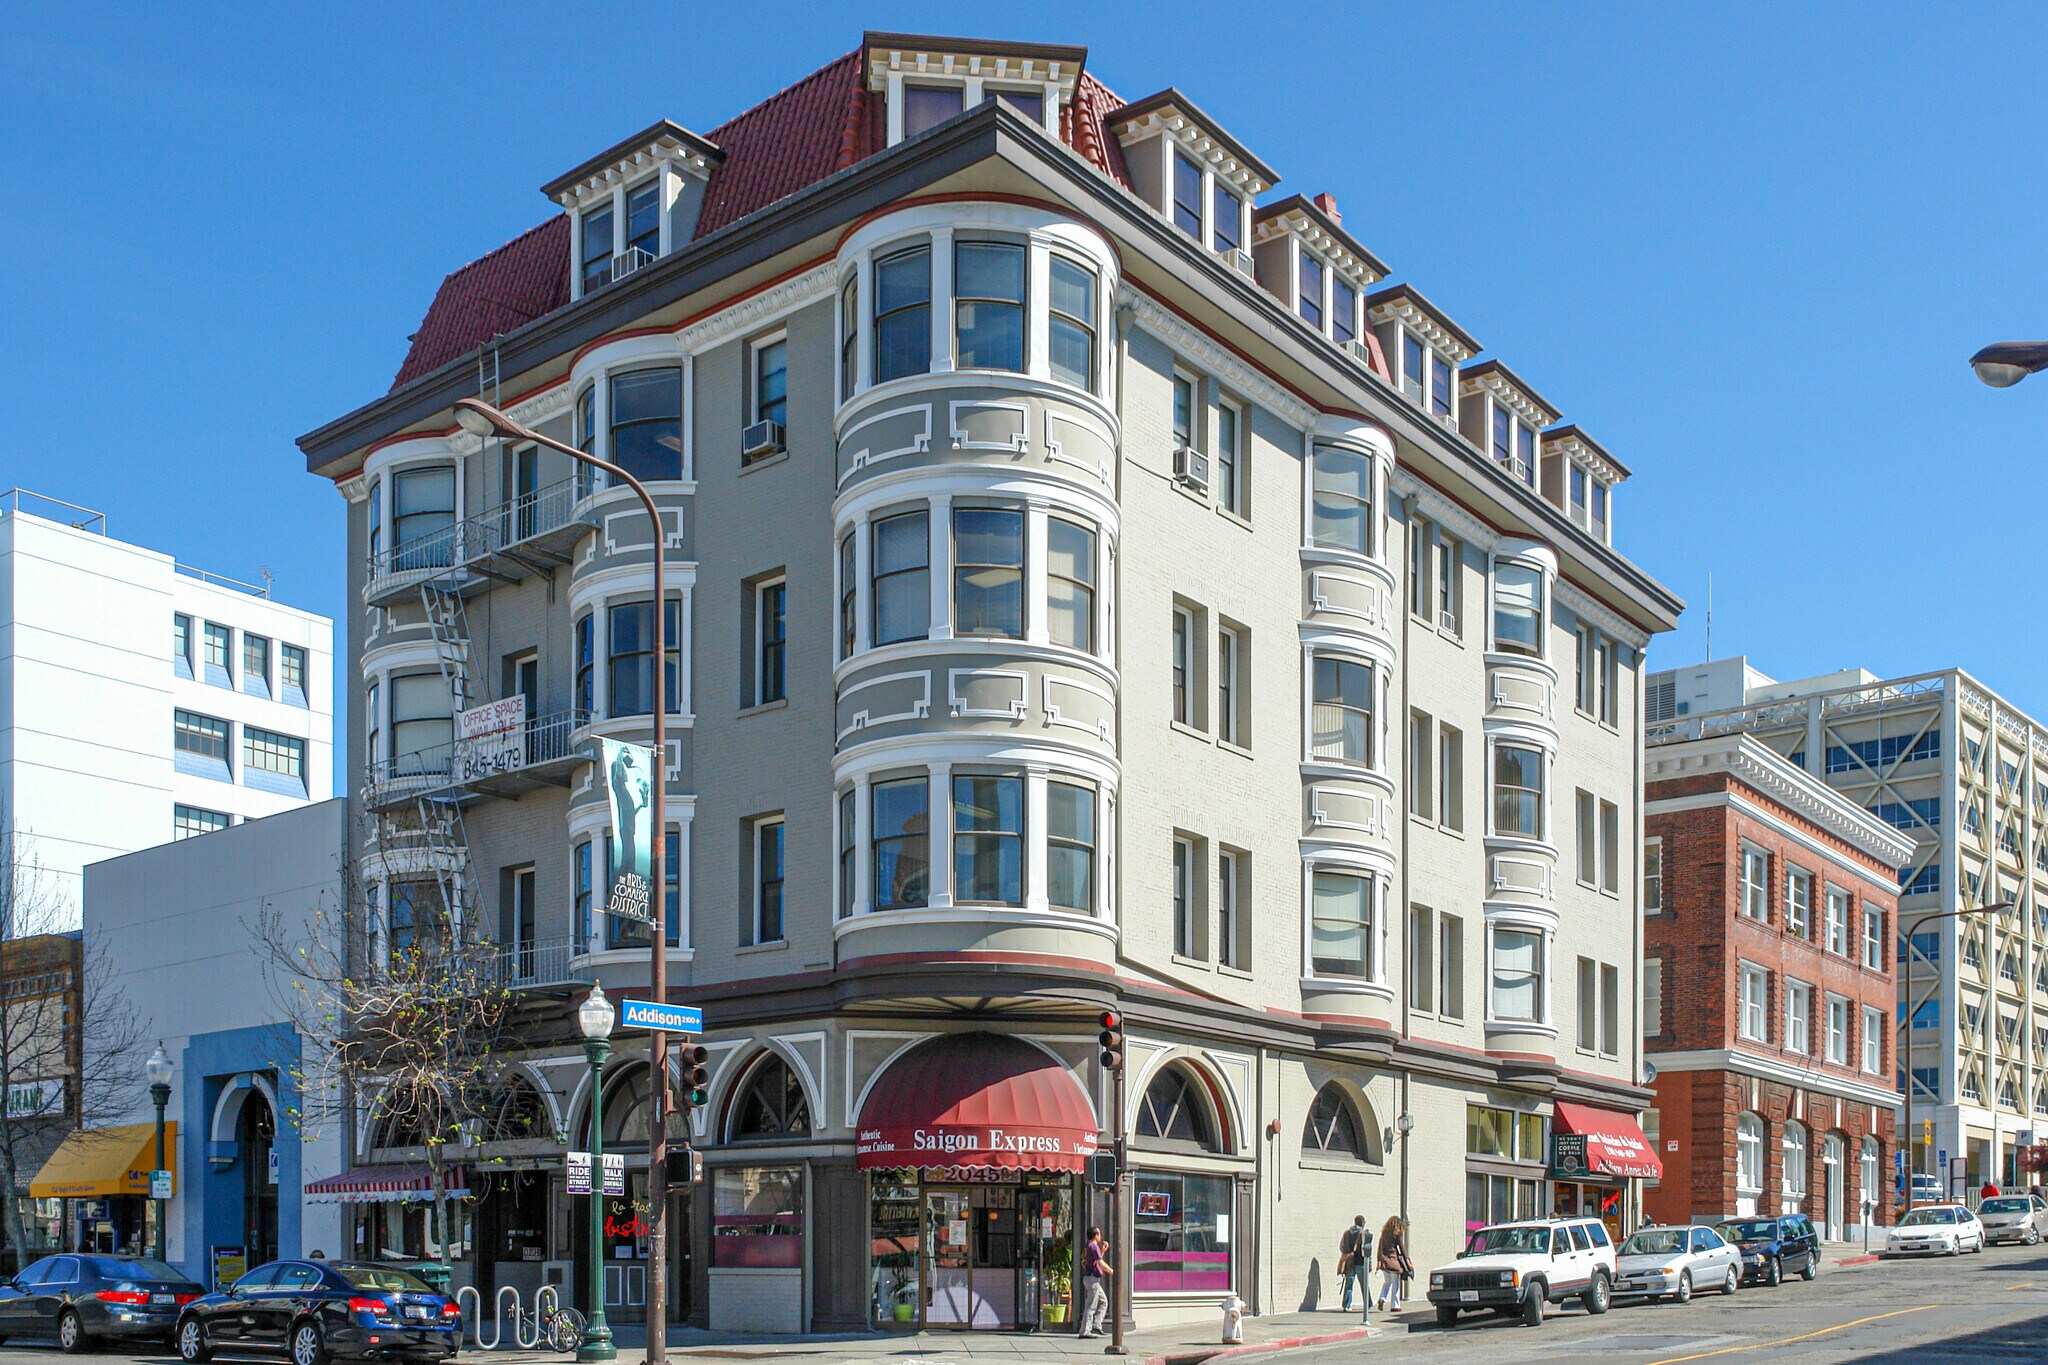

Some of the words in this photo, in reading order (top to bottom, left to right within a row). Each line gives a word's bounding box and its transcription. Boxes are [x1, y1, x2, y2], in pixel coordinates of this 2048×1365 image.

[463, 707, 491, 728] OFFICE
[495, 698, 522, 719] SPACE
[469, 716, 516, 741] AVAILABLE
[464, 747, 520, 779] 845-1479
[627, 872, 642, 889] ARTS
[642, 881, 647, 890] &
[614, 883, 649, 903] COMMERCE
[610, 894, 649, 918] DISTRICT
[627, 1006, 682, 1026] Addison
[861, 1129, 881, 1140] Authentic
[914, 1129, 978, 1153] Saigon
[989, 1129, 1060, 1155] Express
[873, 1141, 895, 1152] Cuisine
[569, 1167, 590, 1176] RIDE
[604, 1169, 623, 1177] WALK
[945, 1166, 1000, 1181] 2045
[1597, 1160, 1622, 1176] Addison
[631, 1200, 650, 1213] ros
[1140, 1195, 1167, 1213] OPEN
[605, 1215, 650, 1237] bistr
